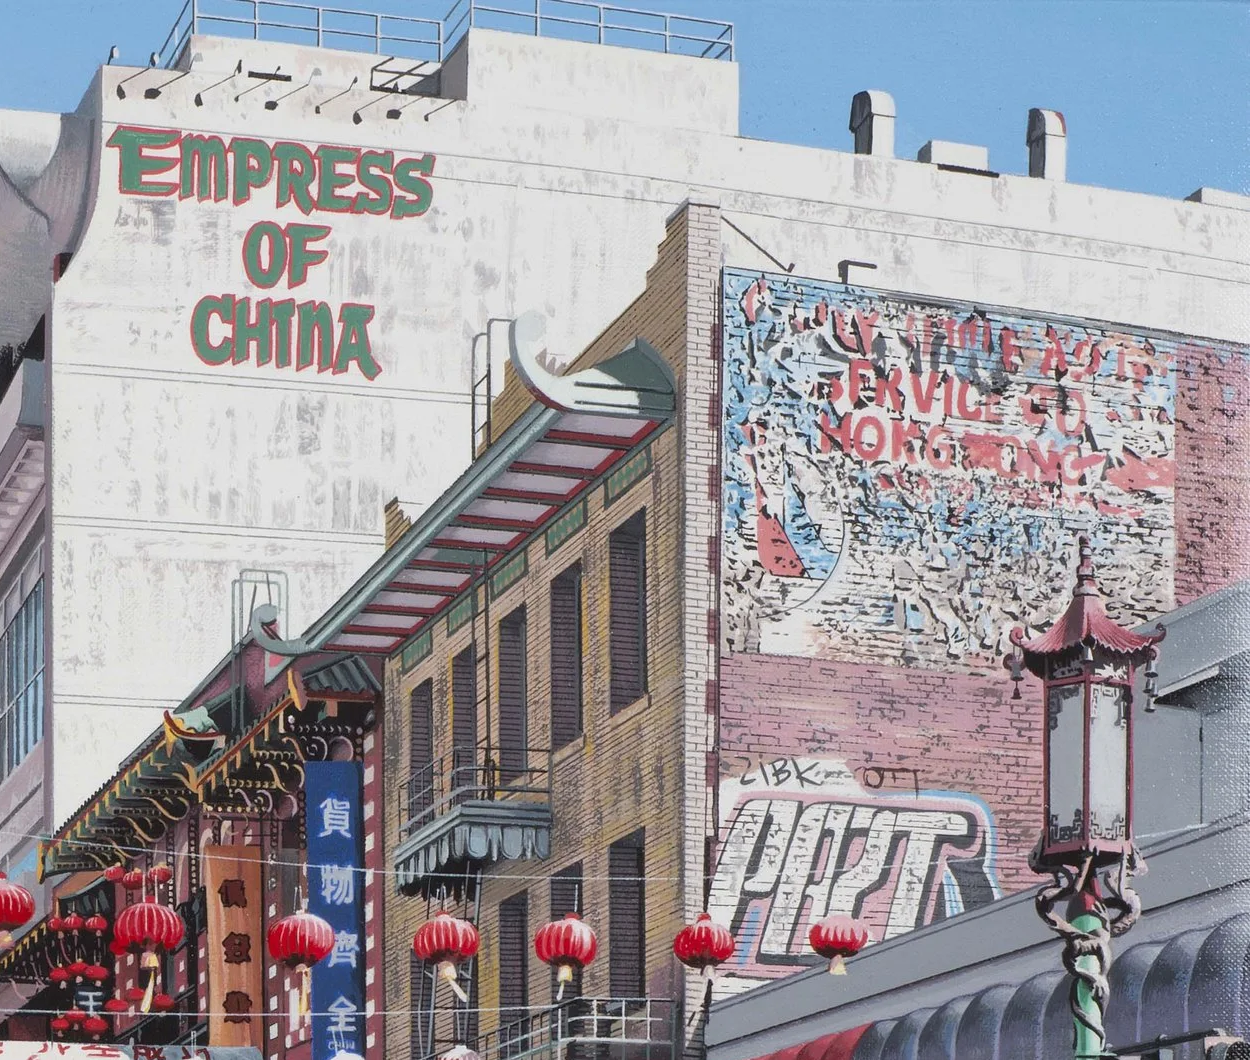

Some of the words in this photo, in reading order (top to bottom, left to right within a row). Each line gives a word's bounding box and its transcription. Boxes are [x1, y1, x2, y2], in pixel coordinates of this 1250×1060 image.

[106, 125, 436, 219] EMPRESS
[242, 221, 332, 289] OF
[190, 294, 382, 380] CHINA
